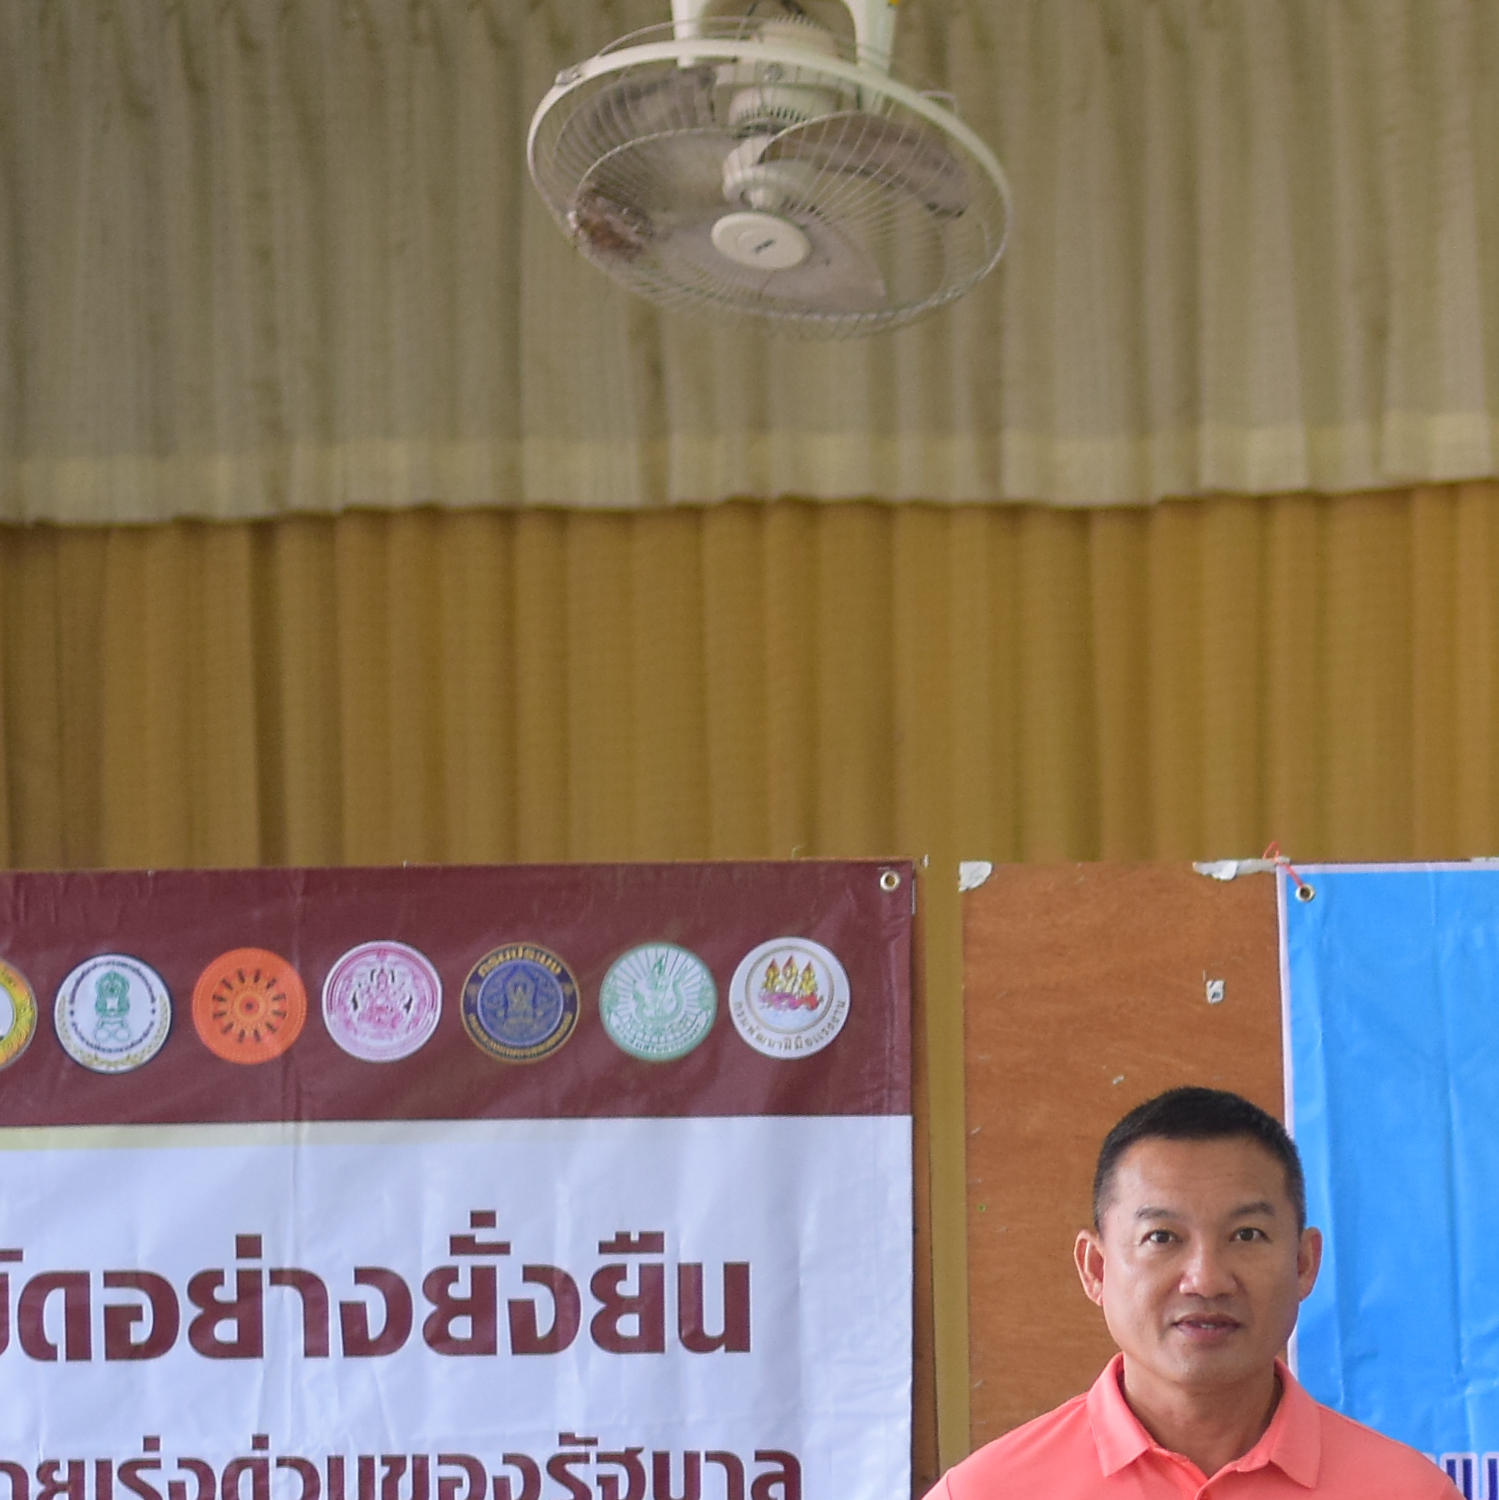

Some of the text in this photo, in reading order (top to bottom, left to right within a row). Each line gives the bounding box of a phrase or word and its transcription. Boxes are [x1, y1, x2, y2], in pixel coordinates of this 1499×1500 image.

[0, 1210, 753, 1363] ดอย่างยั่งยืน
